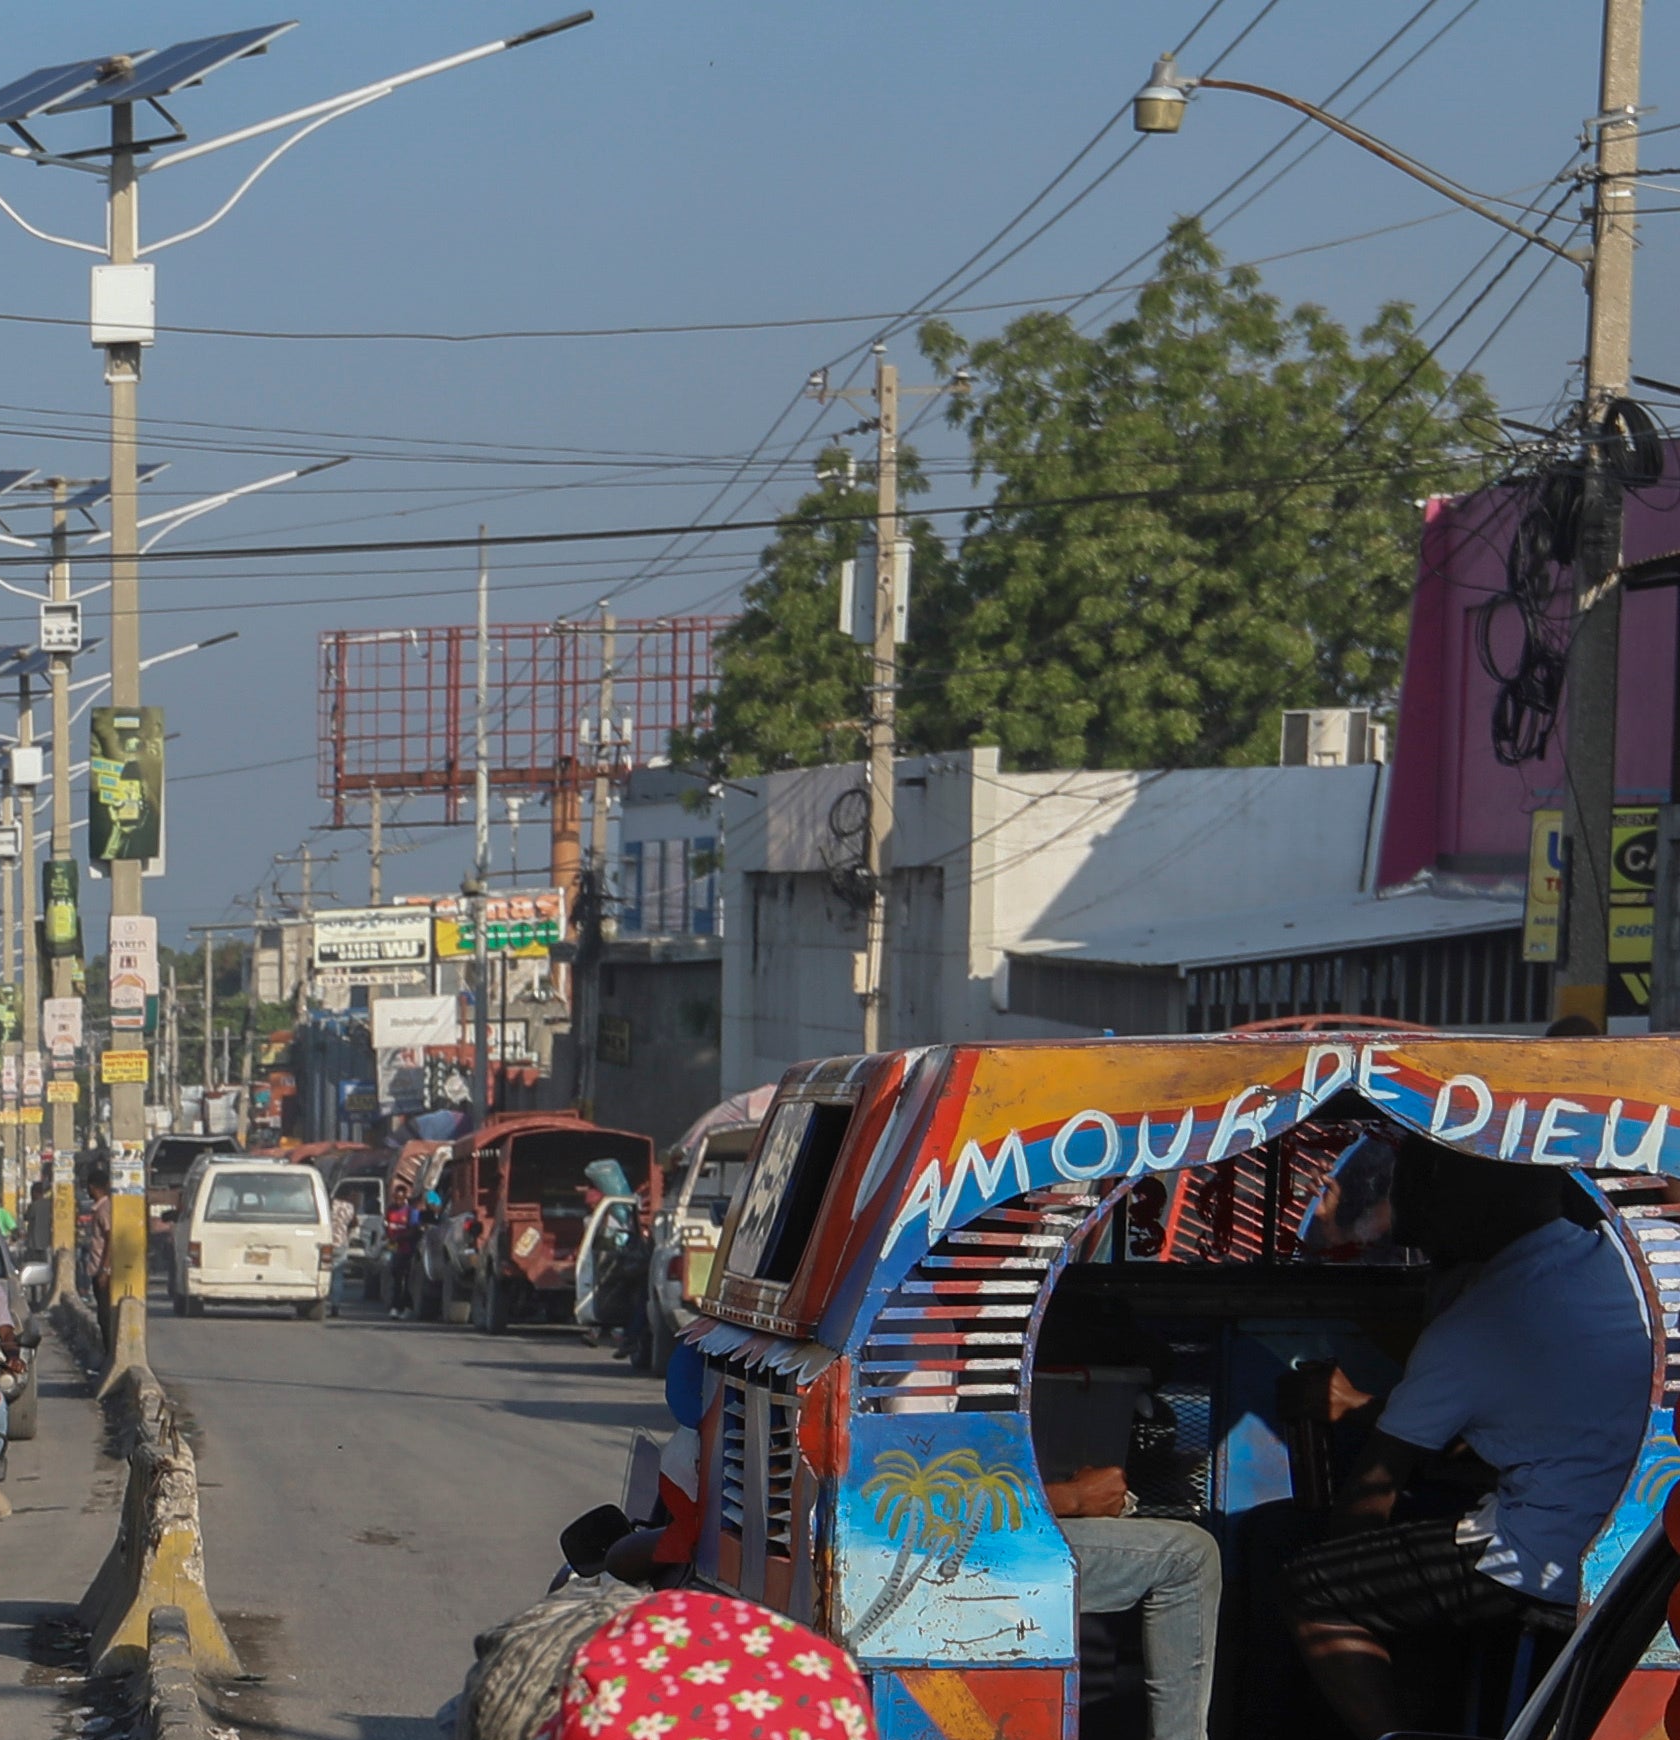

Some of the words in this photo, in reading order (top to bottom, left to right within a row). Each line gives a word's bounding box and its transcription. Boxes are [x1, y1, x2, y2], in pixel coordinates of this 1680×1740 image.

[320, 943, 379, 953] WESTERN
[384, 940, 419, 958] WU
[338, 952, 379, 960] UNION
[880, 1085, 1278, 1261] AMOUR
[1296, 1044, 1401, 1121] DE
[1430, 1074, 1669, 1173] DIEU
